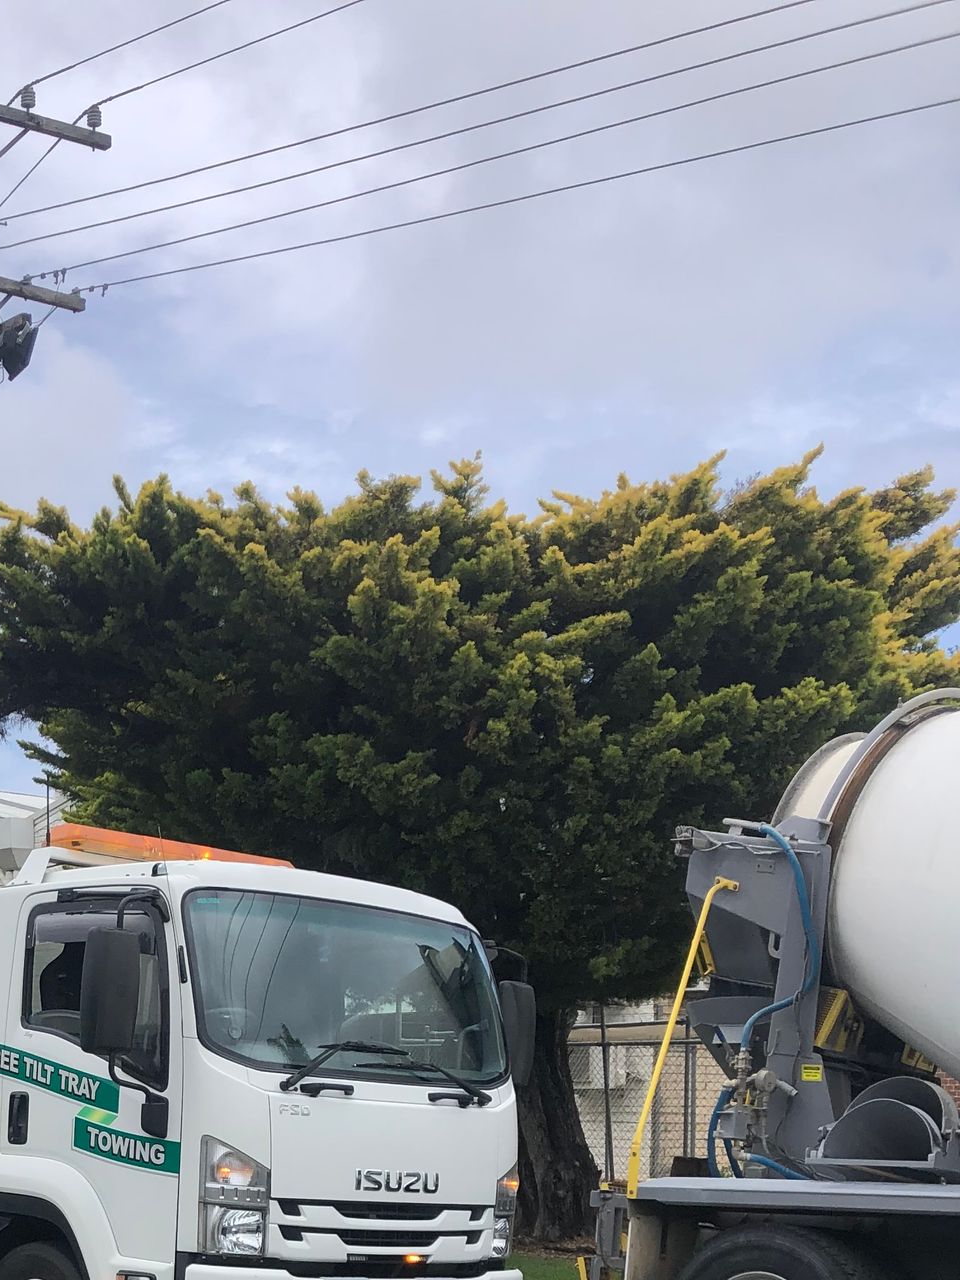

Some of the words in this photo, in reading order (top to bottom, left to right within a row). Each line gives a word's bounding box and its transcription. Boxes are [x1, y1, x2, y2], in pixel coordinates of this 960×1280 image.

[23, 1056, 55, 1086] TILT
[58, 1068, 100, 1101] TRAY
[87, 1126, 165, 1165] TOWING
[355, 1168, 439, 1194] ISUZU
